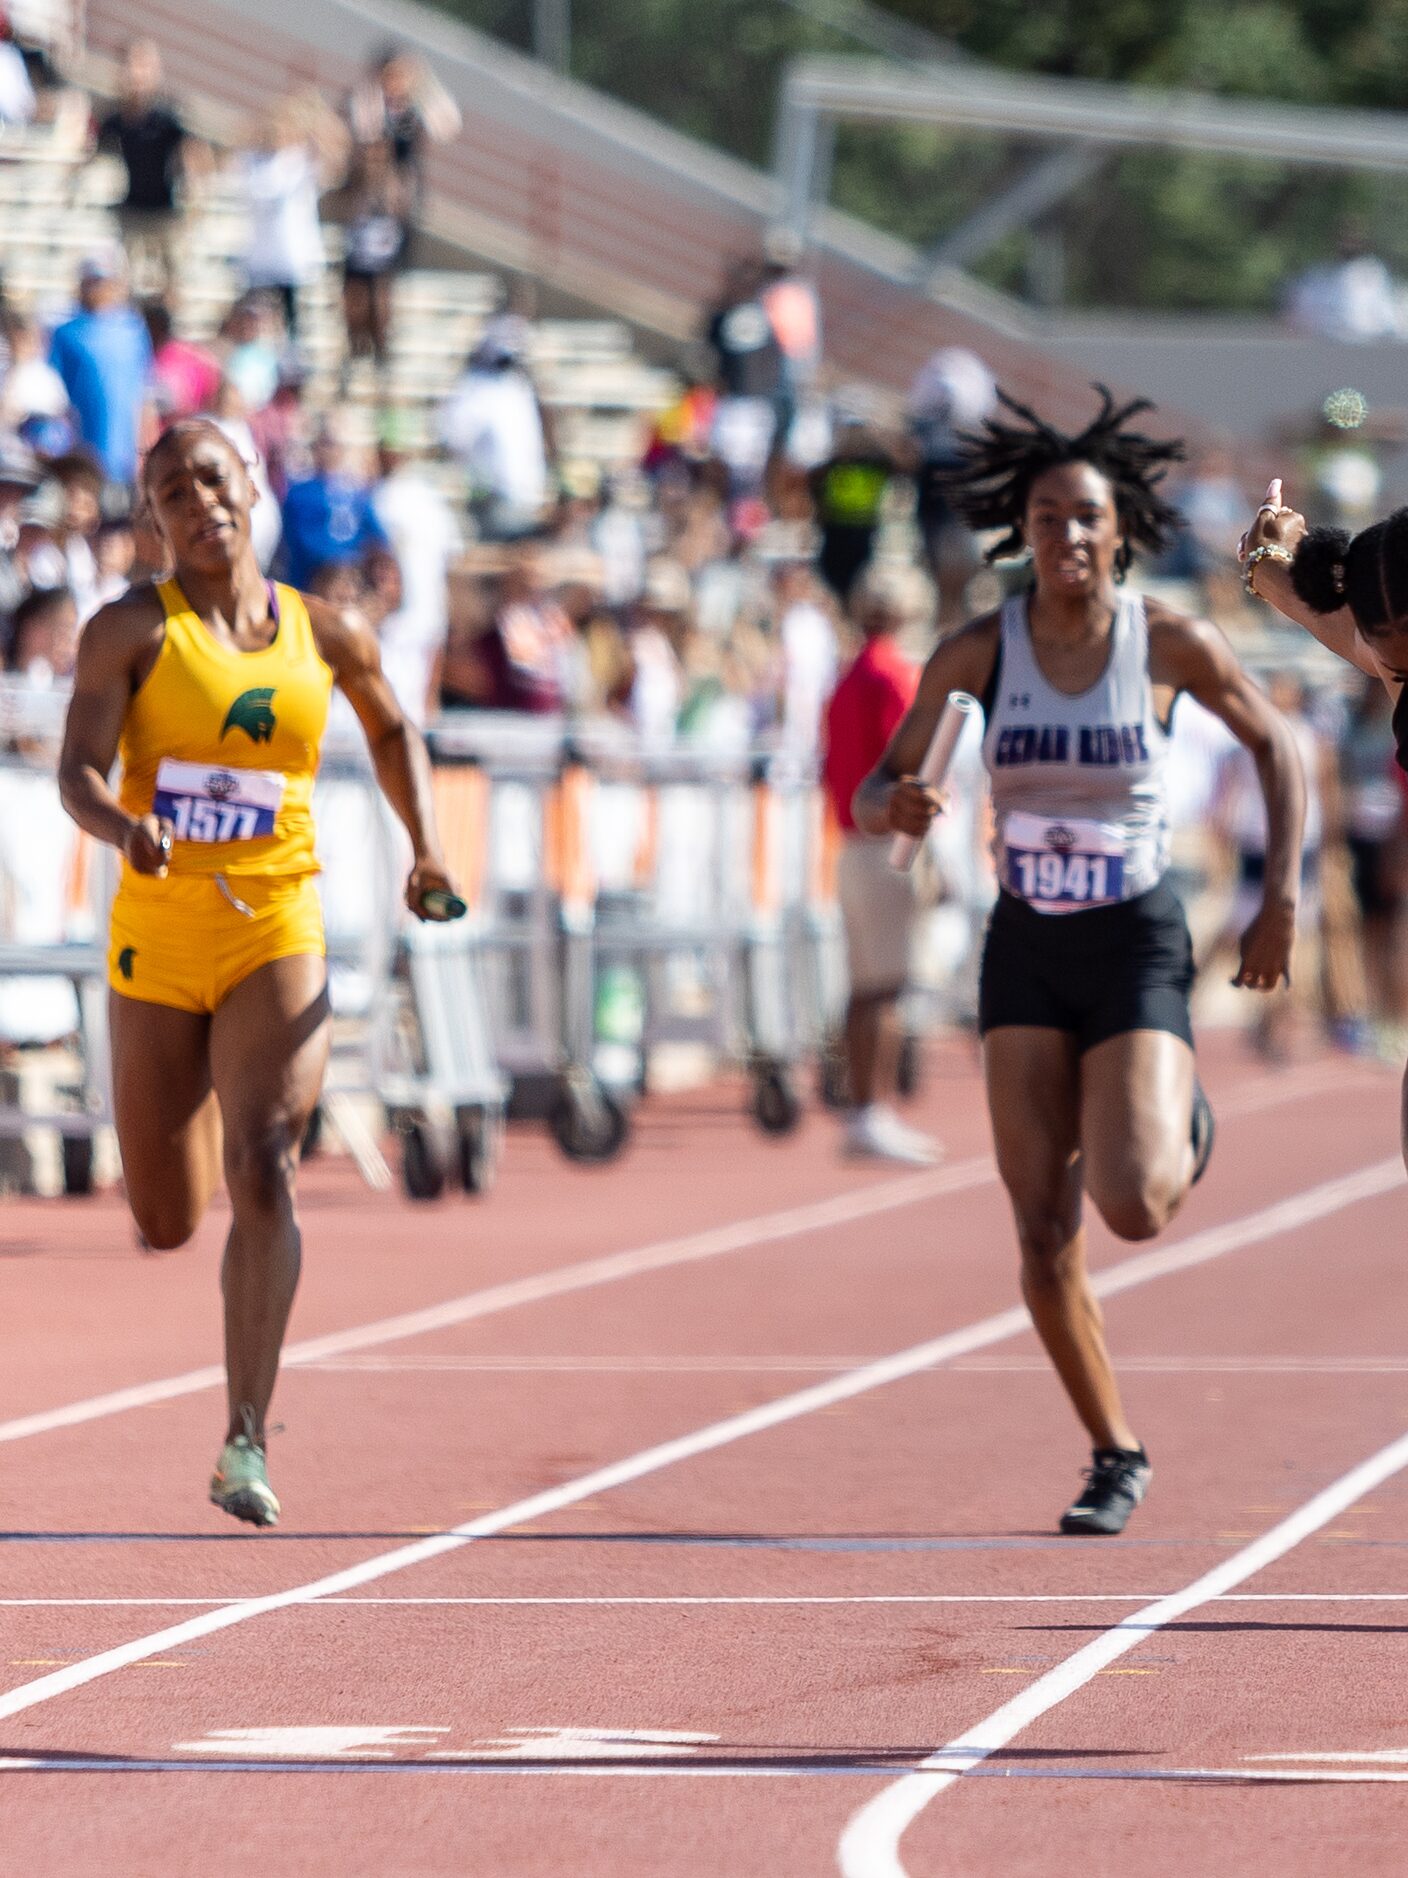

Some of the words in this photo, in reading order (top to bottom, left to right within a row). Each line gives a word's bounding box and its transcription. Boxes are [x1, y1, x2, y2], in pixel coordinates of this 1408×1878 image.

[996, 724, 1068, 767] CEDAR
[1078, 723, 1149, 767] RIDGE
[172, 797, 259, 843] 1577
[1015, 854, 1108, 901] 1941
